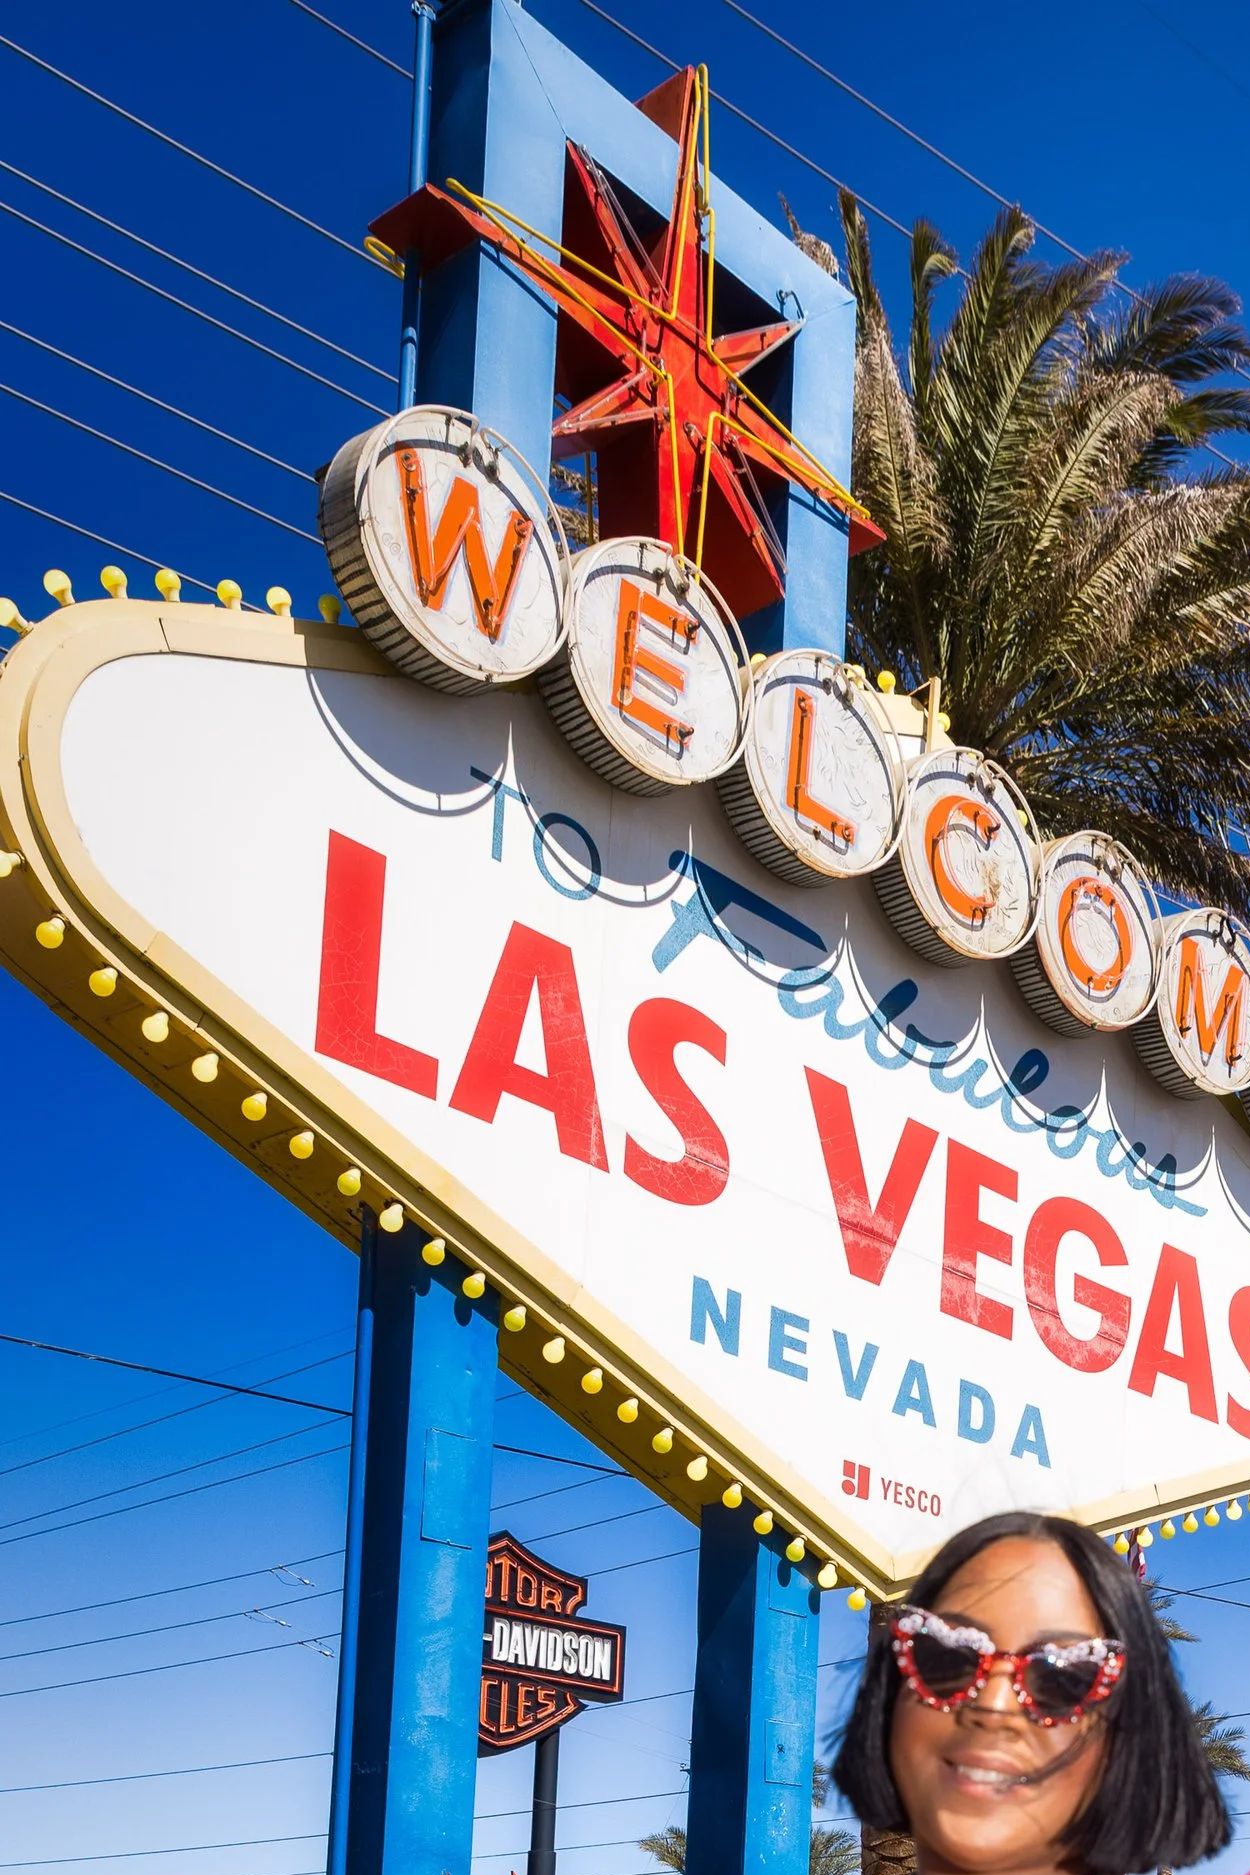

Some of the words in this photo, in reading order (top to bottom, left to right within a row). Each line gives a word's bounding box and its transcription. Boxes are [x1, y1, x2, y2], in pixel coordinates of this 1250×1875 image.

[313, 828, 731, 1206] LAS
[469, 765, 602, 901] TO
[650, 848, 1206, 1217] Fabulous
[689, 1275, 1054, 1469] NEVADA
[880, 1476, 942, 1517] YESCO
